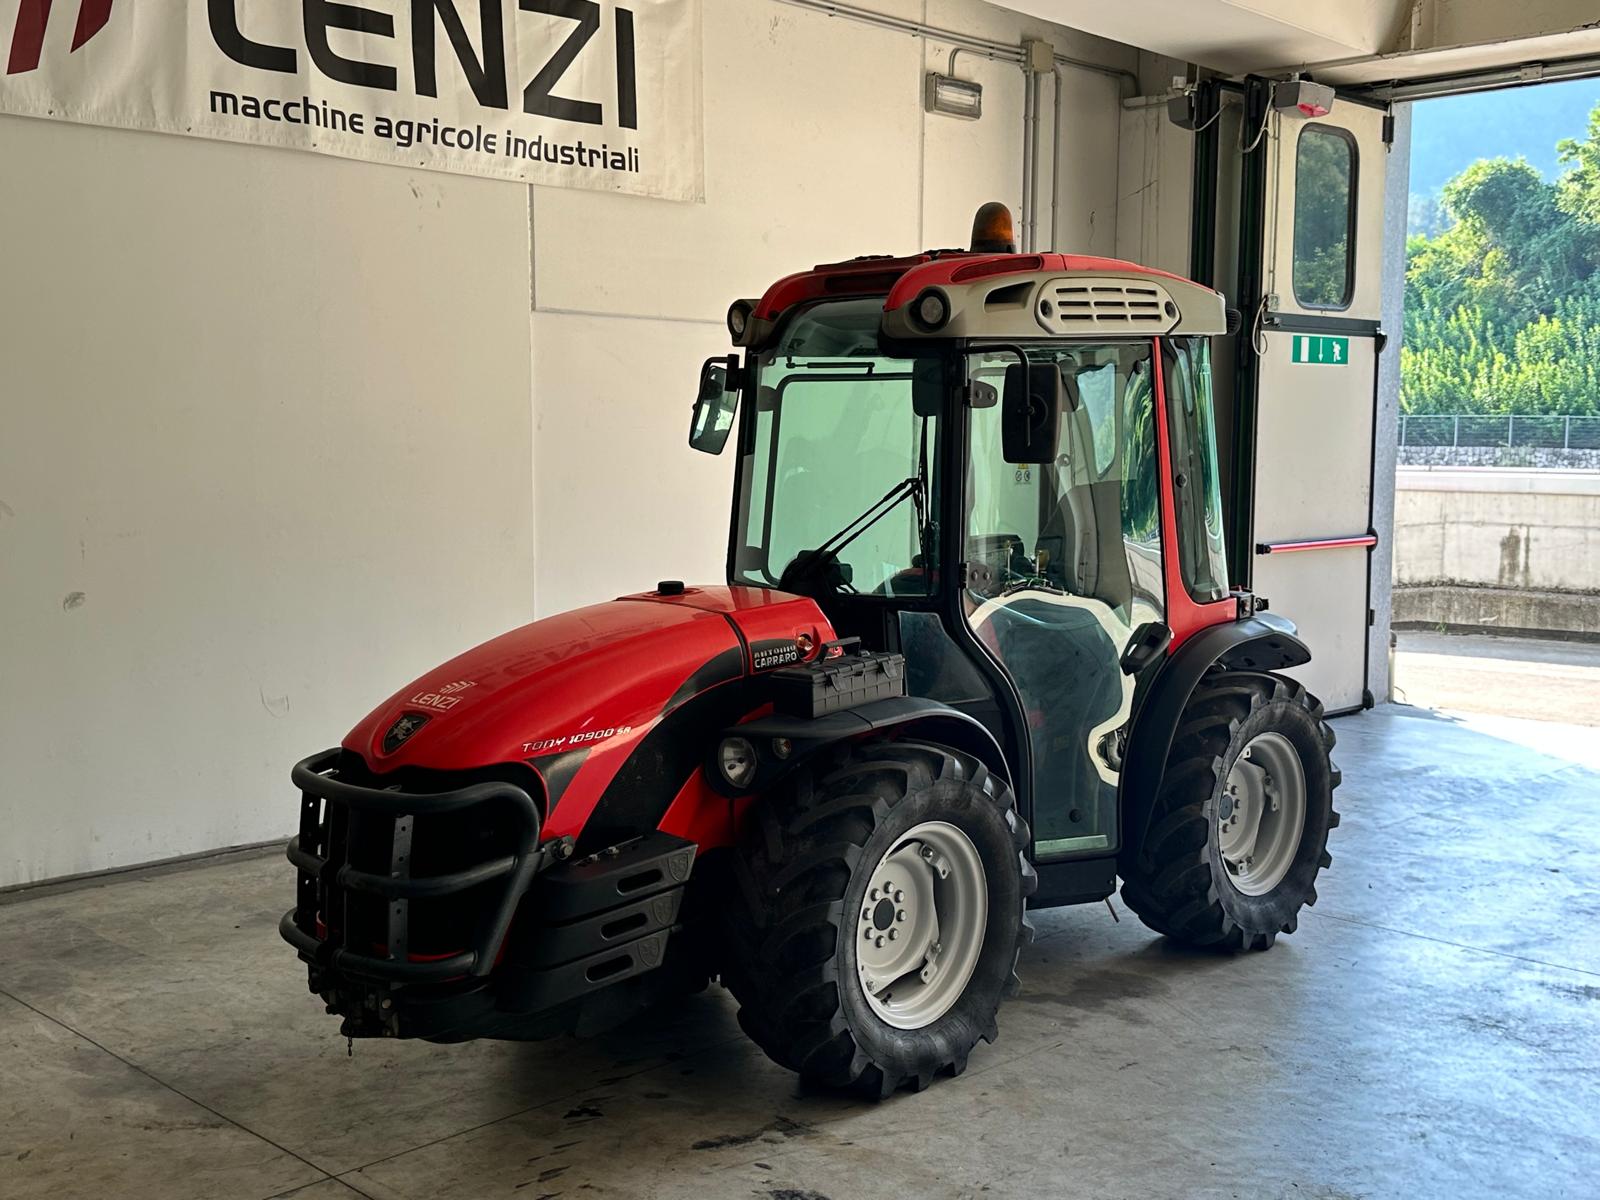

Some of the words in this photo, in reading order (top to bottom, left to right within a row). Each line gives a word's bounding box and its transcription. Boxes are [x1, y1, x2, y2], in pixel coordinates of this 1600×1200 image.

[207, 0, 638, 131] LENZI
[210, 90, 364, 134] macchine
[374, 116, 497, 154] agricole
[505, 130, 639, 172] industriali
[754, 645, 796, 658] ANTONIO
[754, 651, 798, 668] CARRARO
[411, 691, 461, 710] LENZI
[522, 737, 566, 753] TONY
[568, 727, 615, 744] 10900
